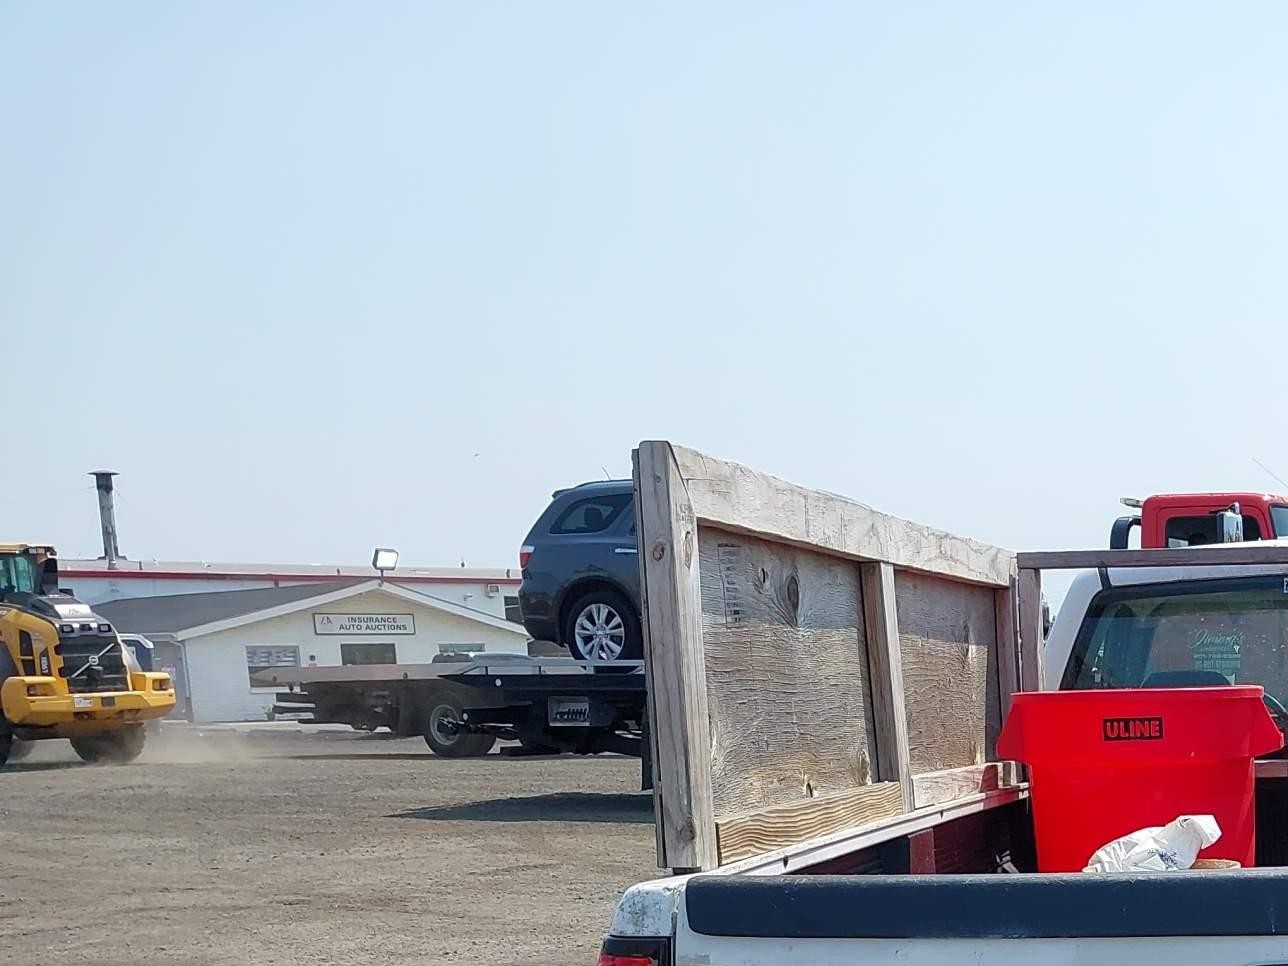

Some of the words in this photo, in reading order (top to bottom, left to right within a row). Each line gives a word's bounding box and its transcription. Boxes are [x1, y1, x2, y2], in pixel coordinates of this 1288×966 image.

[339, 623, 362, 631] AUTO
[365, 623, 407, 631] AUCTIONS
[1106, 720, 1160, 738] ULINE
